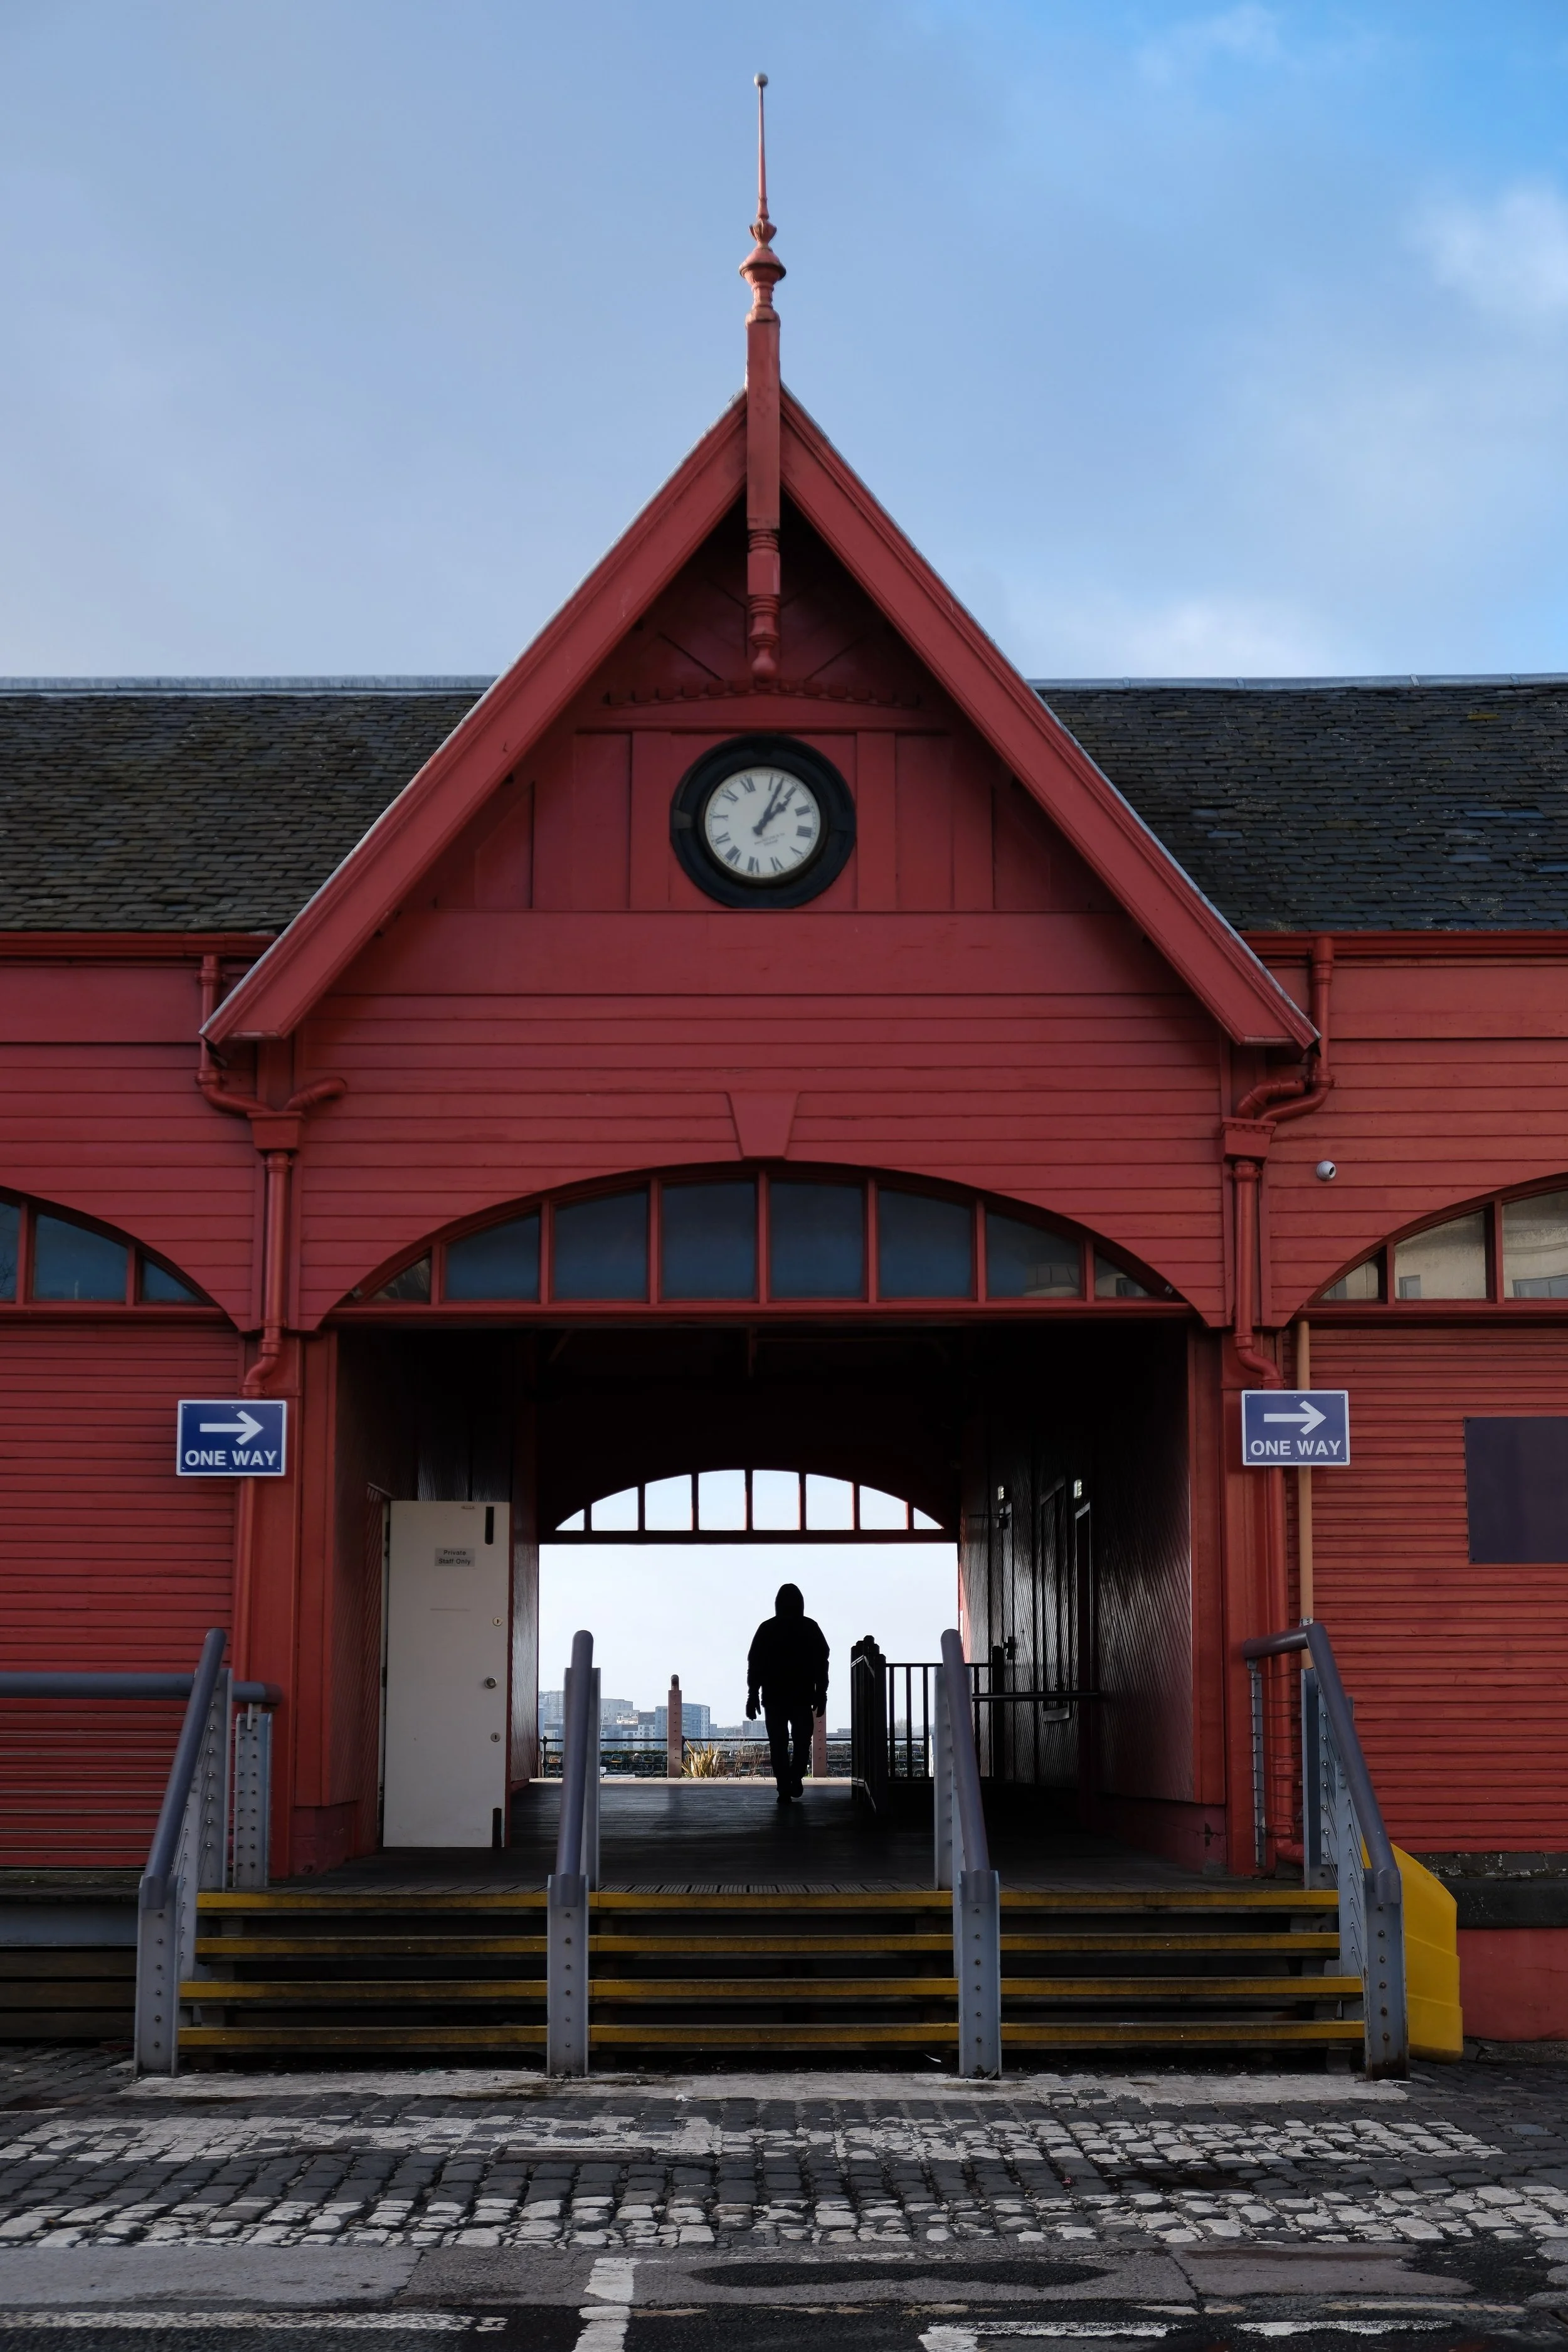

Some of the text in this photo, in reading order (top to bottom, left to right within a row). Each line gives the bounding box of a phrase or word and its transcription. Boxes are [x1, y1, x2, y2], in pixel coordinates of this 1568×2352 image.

[740, 776, 756, 794] XII
[784, 785, 797, 800] II
[721, 788, 739, 805] XI
[712, 812, 729, 821] X
[795, 805, 811, 817] III
[713, 832, 731, 844] IX
[796, 825, 812, 838] IIII
[725, 845, 742, 865] VIII
[789, 846, 805, 859] V
[747, 856, 760, 872] VII
[770, 856, 784, 871] VI
[1251, 1440, 1341, 1456] ONE WAY
[184, 1450, 277, 1466] ONE WAY
